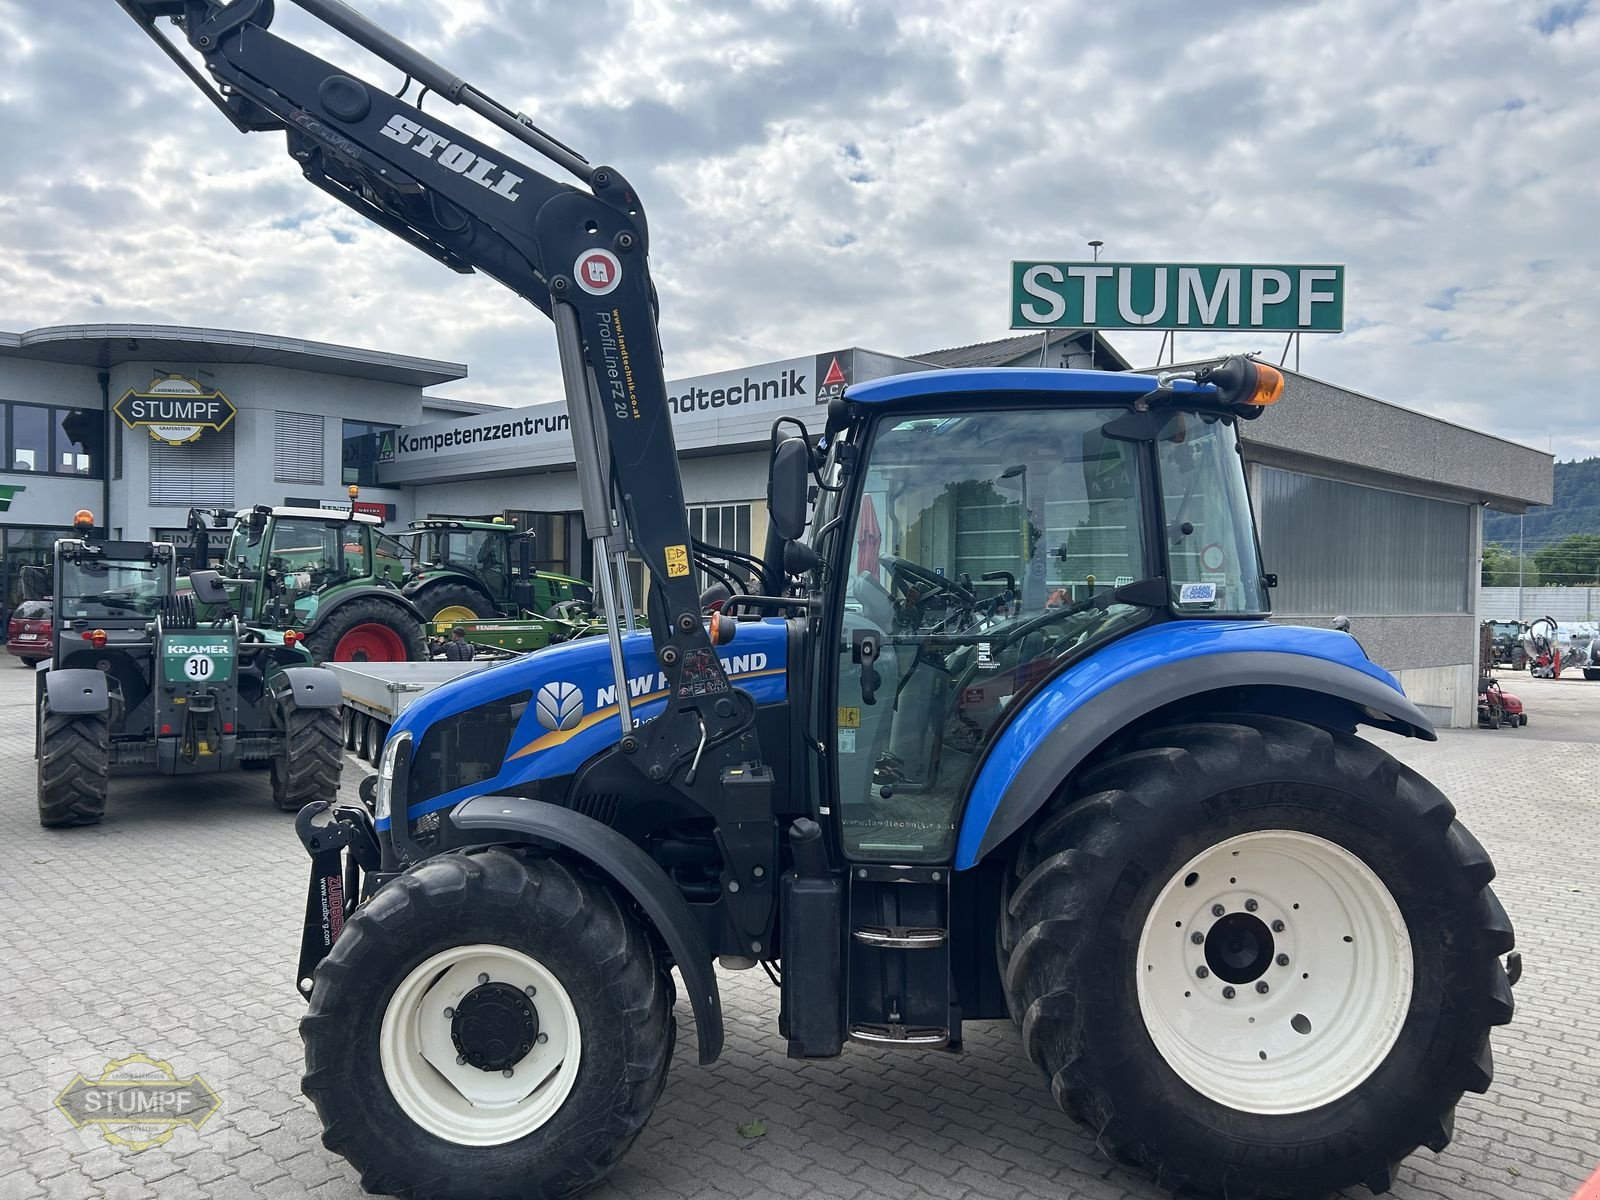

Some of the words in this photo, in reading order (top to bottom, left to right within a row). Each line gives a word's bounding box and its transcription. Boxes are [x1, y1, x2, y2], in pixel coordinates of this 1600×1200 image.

[379, 114, 524, 202] STOLL
[1020, 265, 1337, 327] STUMPF
[596, 311, 619, 378] ProfiLine
[612, 307, 641, 419] www.landtechnik.co.at
[609, 380, 626, 399] FZ
[131, 400, 220, 419] STUMPF
[397, 413, 571, 454] Kompetenzzentrum
[668, 369, 807, 415] ndtechnik
[614, 402, 629, 419] 20
[167, 645, 229, 654] KRAMER
[189, 658, 209, 676] 30
[978, 642, 991, 661] PLM
[597, 671, 654, 708] NW
[320, 877, 331, 946] www.zuidbg.com
